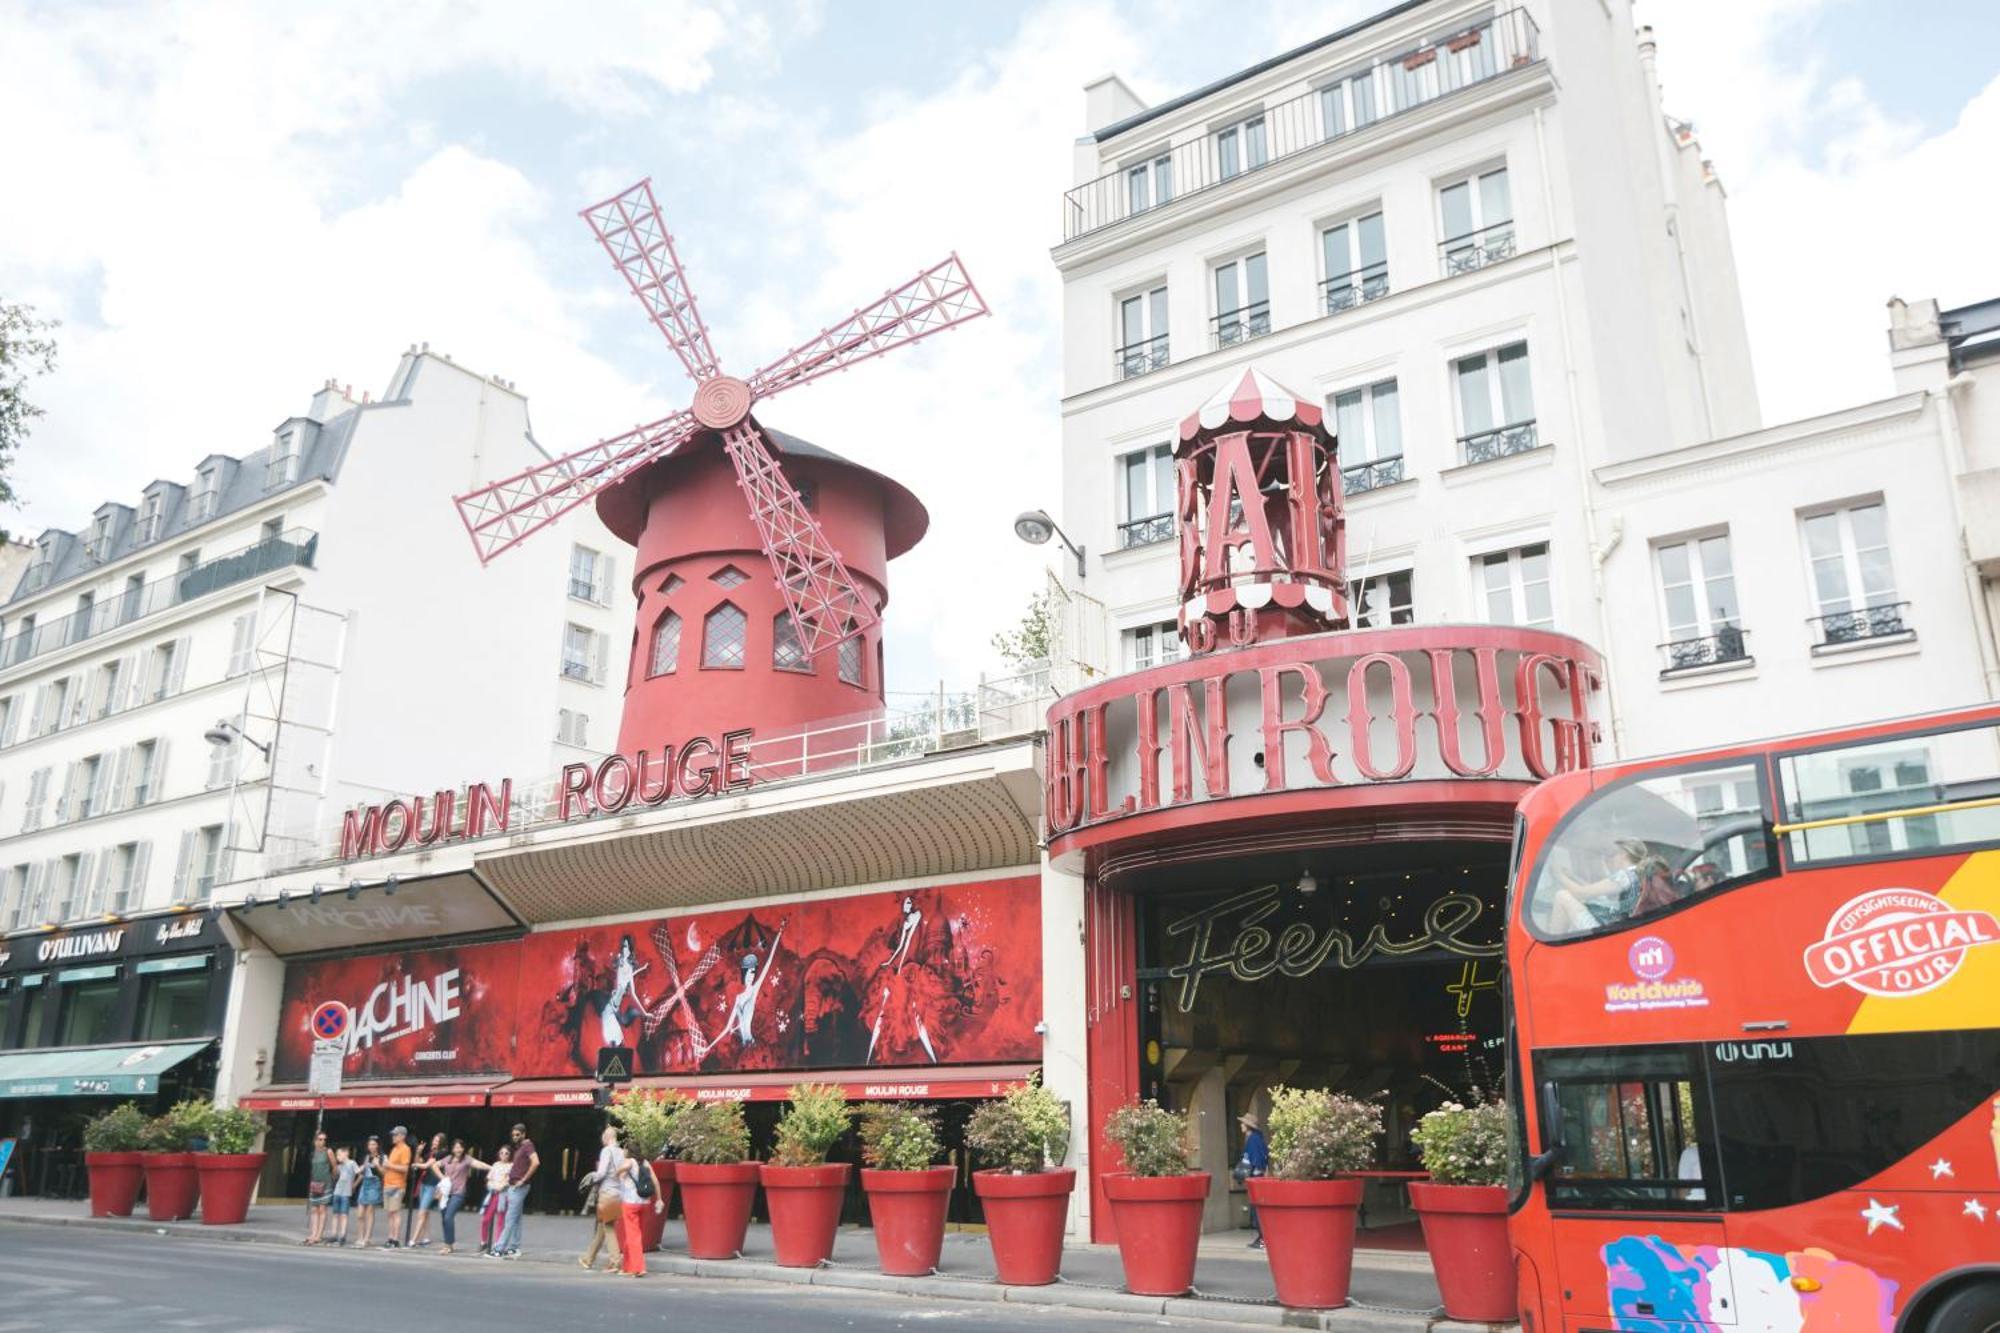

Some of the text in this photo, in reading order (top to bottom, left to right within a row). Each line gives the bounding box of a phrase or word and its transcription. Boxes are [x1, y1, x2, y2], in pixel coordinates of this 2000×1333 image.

[340, 727, 756, 860] MOULIN ROUGE
[1838, 895, 1939, 932] CITYSIGHTSEEING
[38, 930, 125, 961] O'SULLIVANS
[1823, 915, 1993, 975] OFFICIAL
[1879, 955, 1955, 989] TOUR
[1605, 978, 1704, 1002] Worldwide
[578, 1092, 593, 1101] ROU
[697, 1088, 752, 1099] MOULIN ROUGE
[865, 1085, 929, 1096] MOULIN ROUGE
